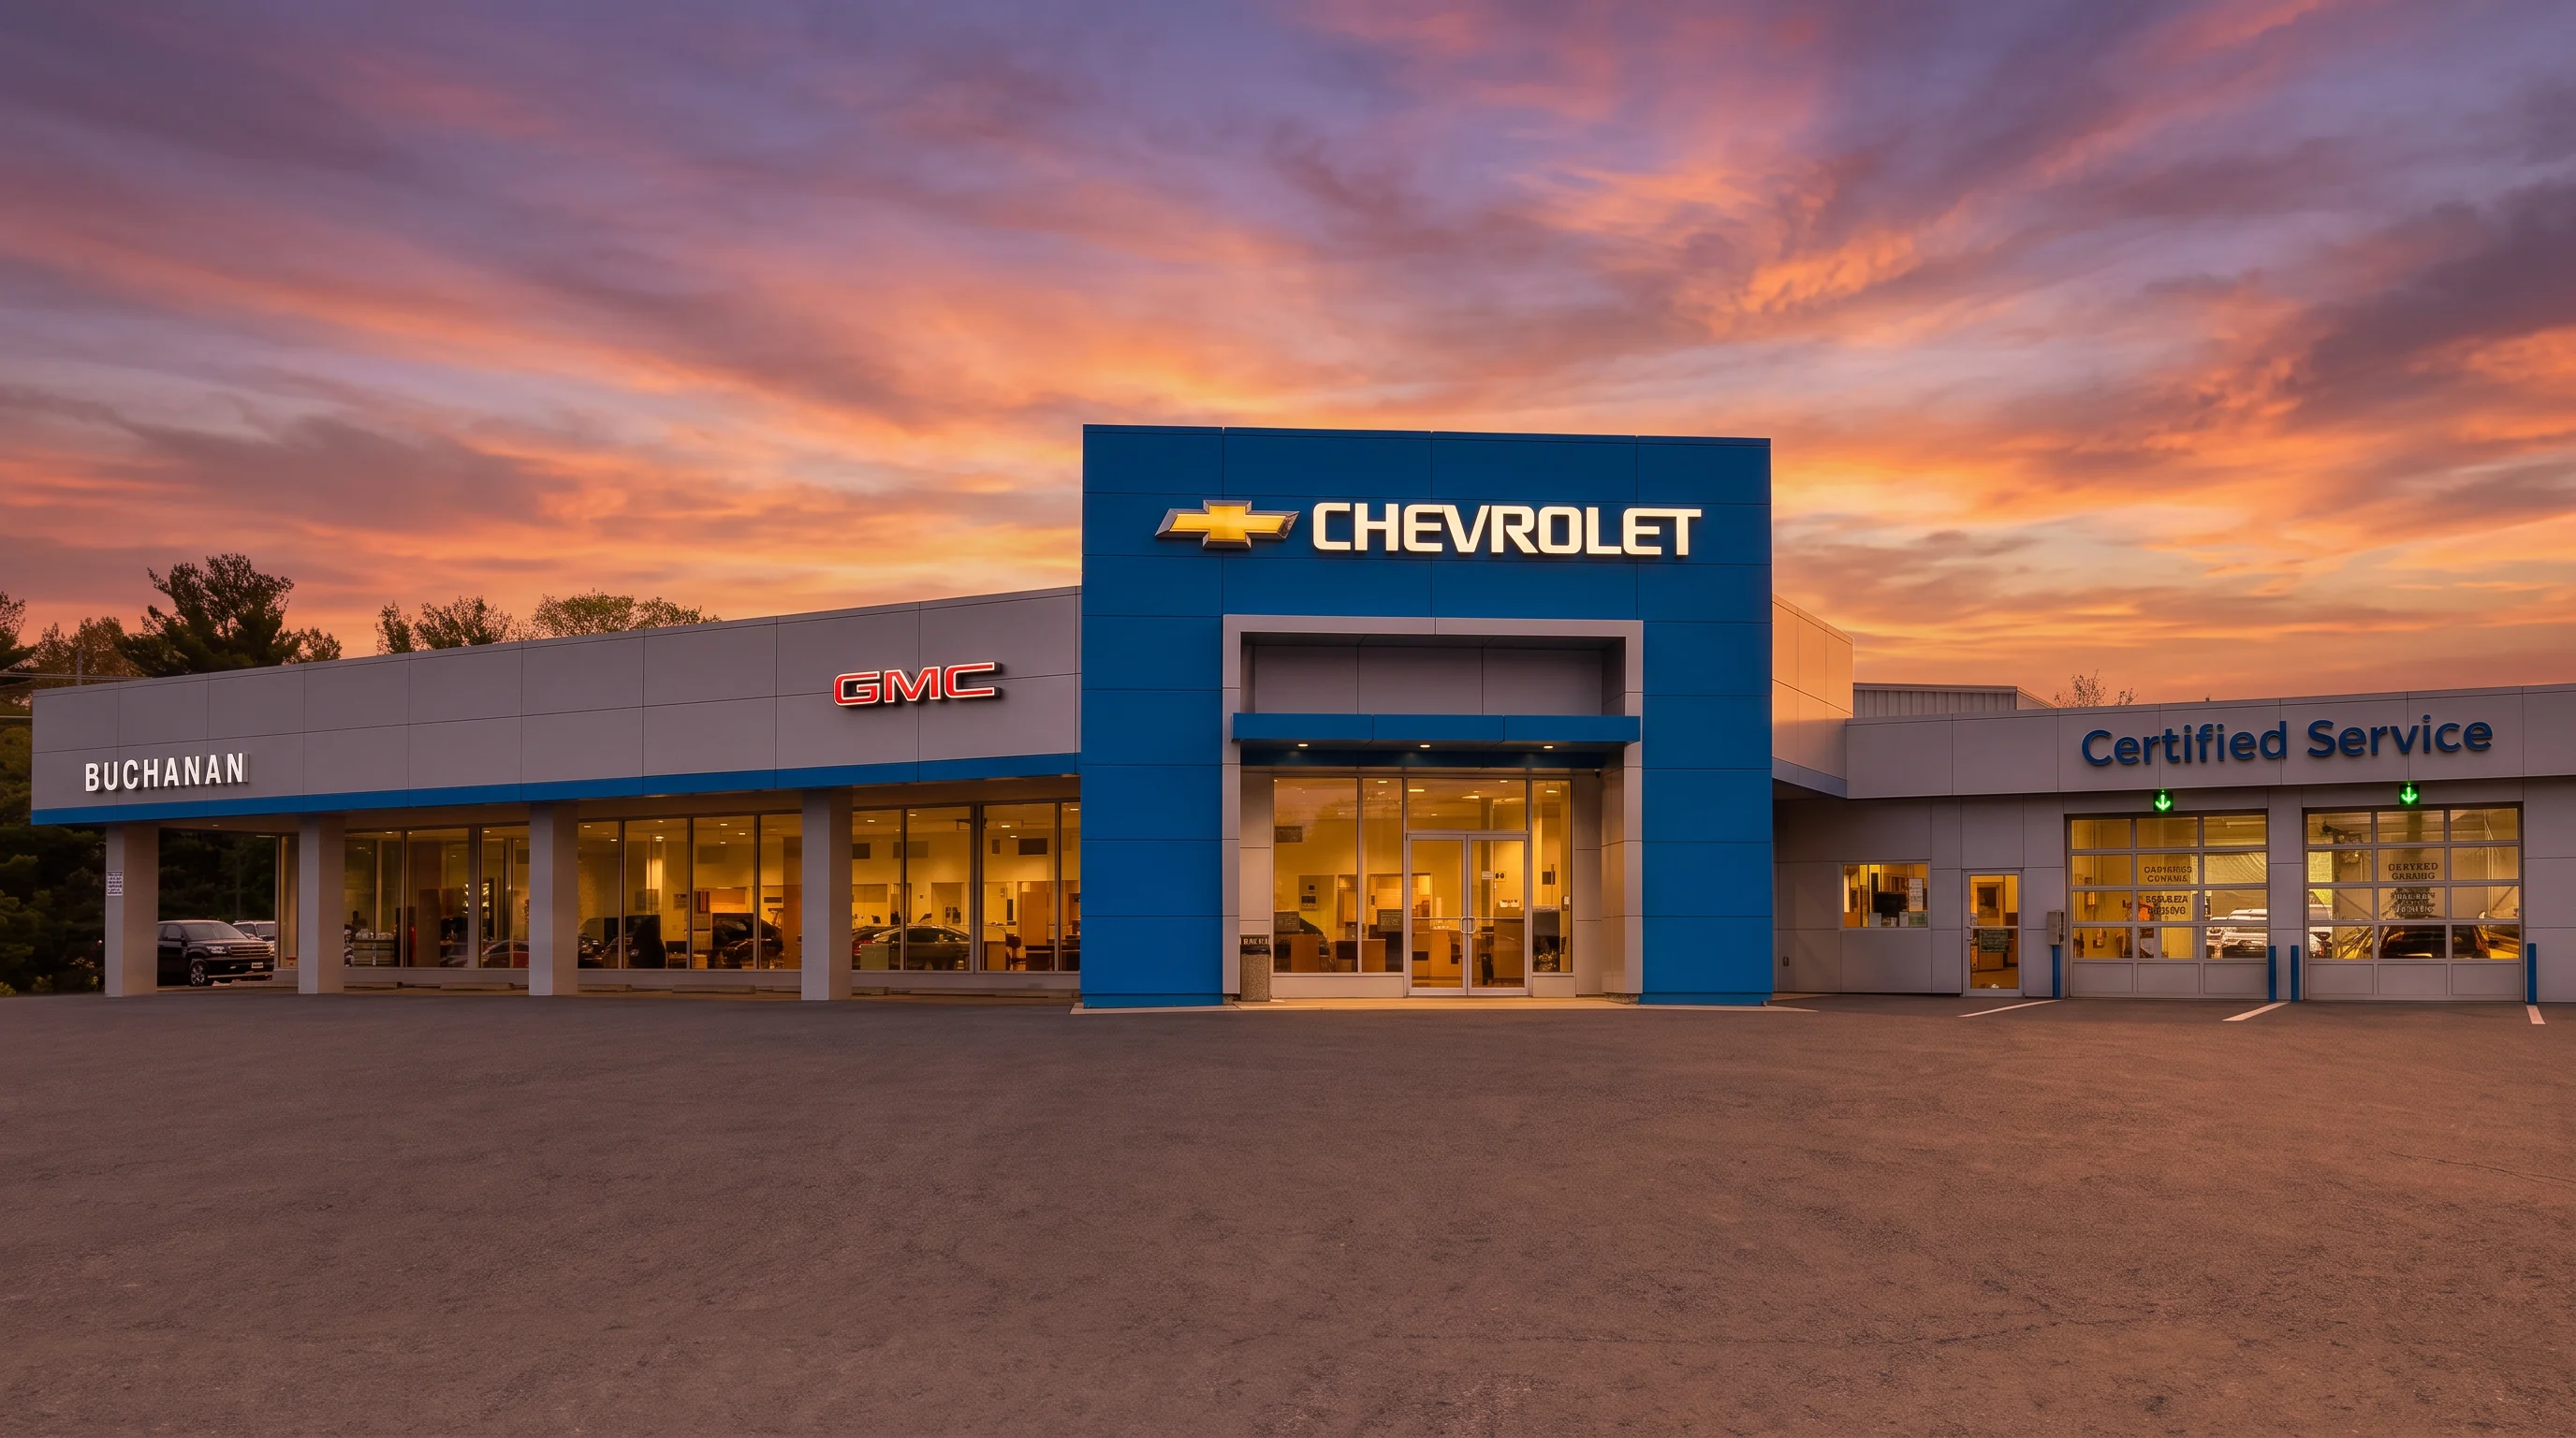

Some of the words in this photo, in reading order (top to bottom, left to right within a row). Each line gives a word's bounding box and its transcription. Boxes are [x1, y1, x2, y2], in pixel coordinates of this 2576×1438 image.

[1312, 502, 1702, 556] CHEVROLET
[833, 661, 996, 706] GMC
[2081, 720, 2288, 767] Certified
[2306, 713, 2494, 757] Service
[85, 752, 244, 792] BUCHANAN
